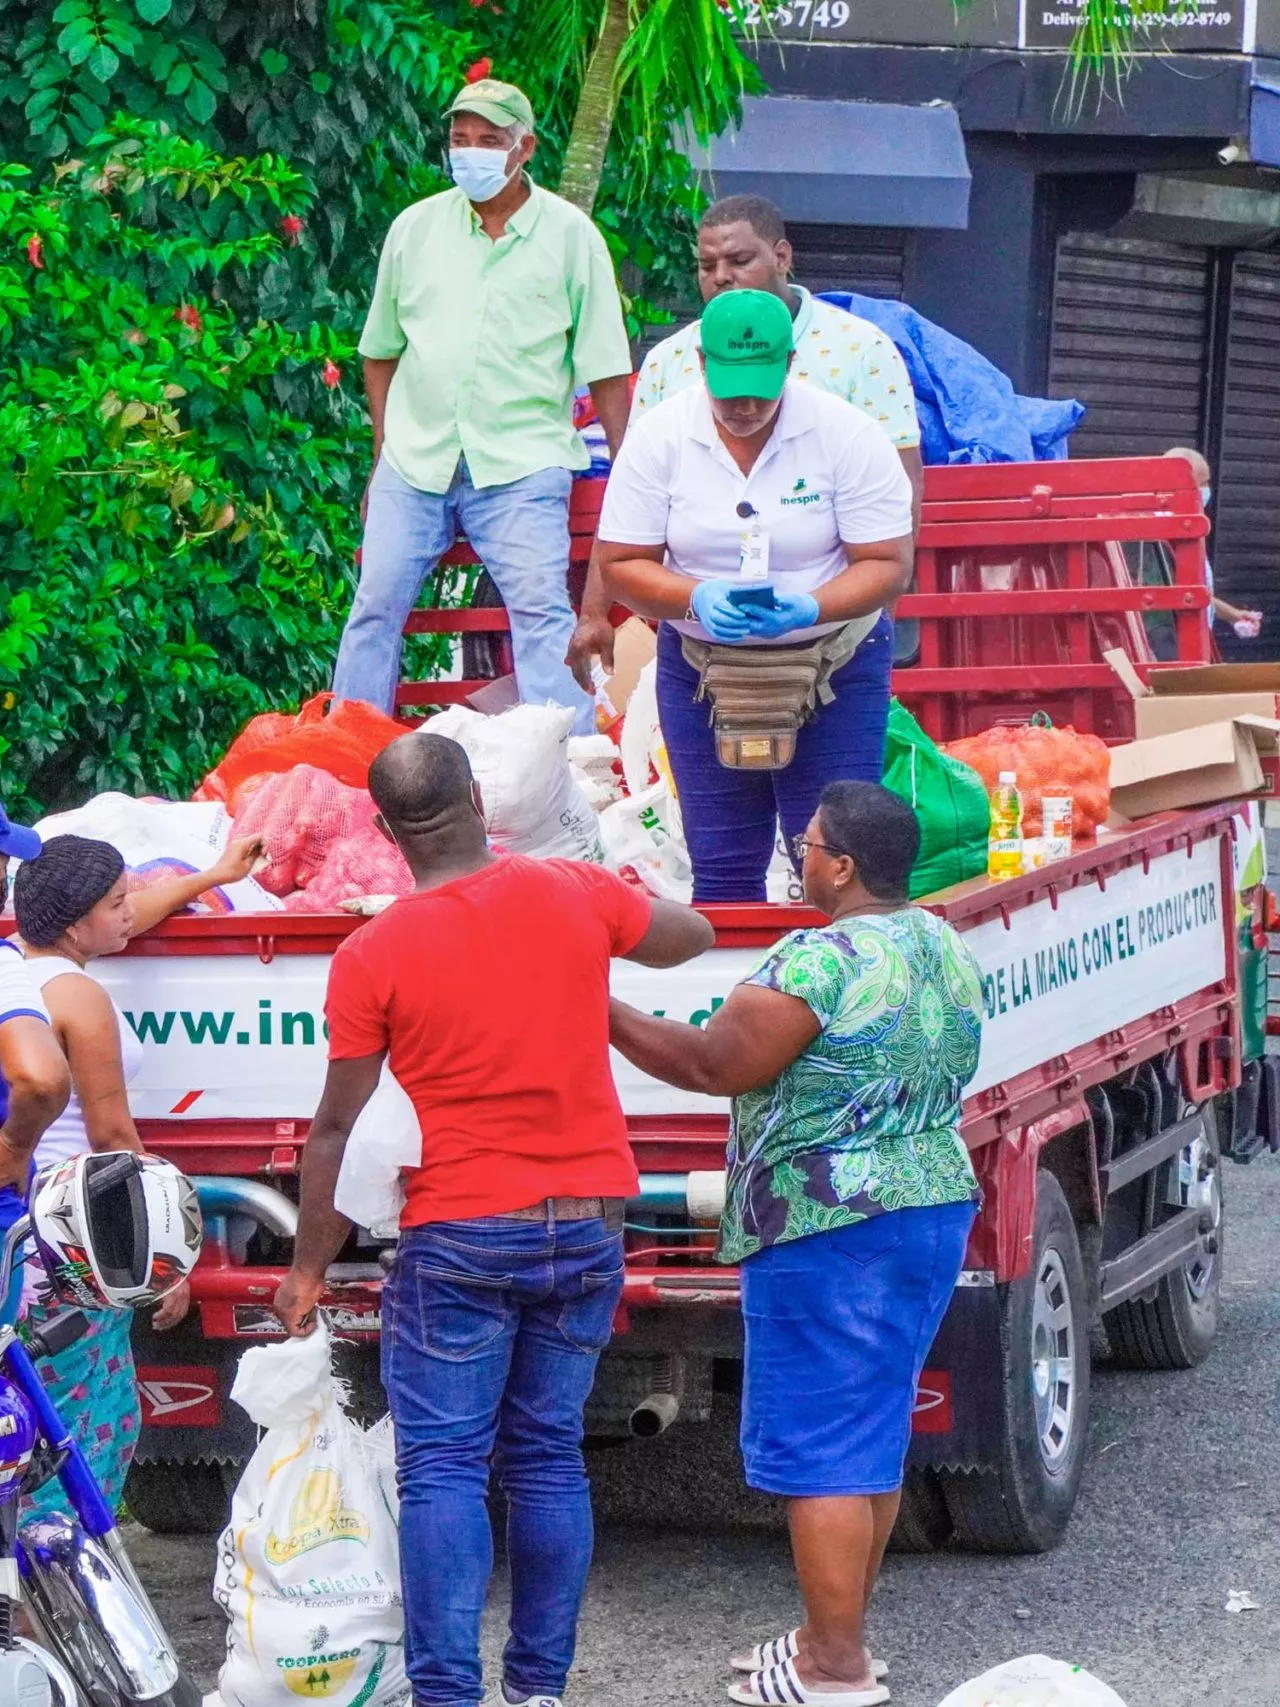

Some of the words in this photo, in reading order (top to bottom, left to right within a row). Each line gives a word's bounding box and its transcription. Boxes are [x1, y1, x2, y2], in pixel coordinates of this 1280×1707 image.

[1042, 11, 1090, 26] Deliver
[780, 493, 820, 506] inespre
[985, 967, 1008, 1020] DE
[1011, 957, 1033, 1008] LA
[1035, 937, 1078, 997] MANO
[1082, 923, 1113, 975] CON
[1115, 914, 1136, 961] EL
[1138, 881, 1217, 951] PRODUCTOR
[121, 999, 329, 1045] ww.in
[276, 1646, 361, 1669] COOPAGRO
